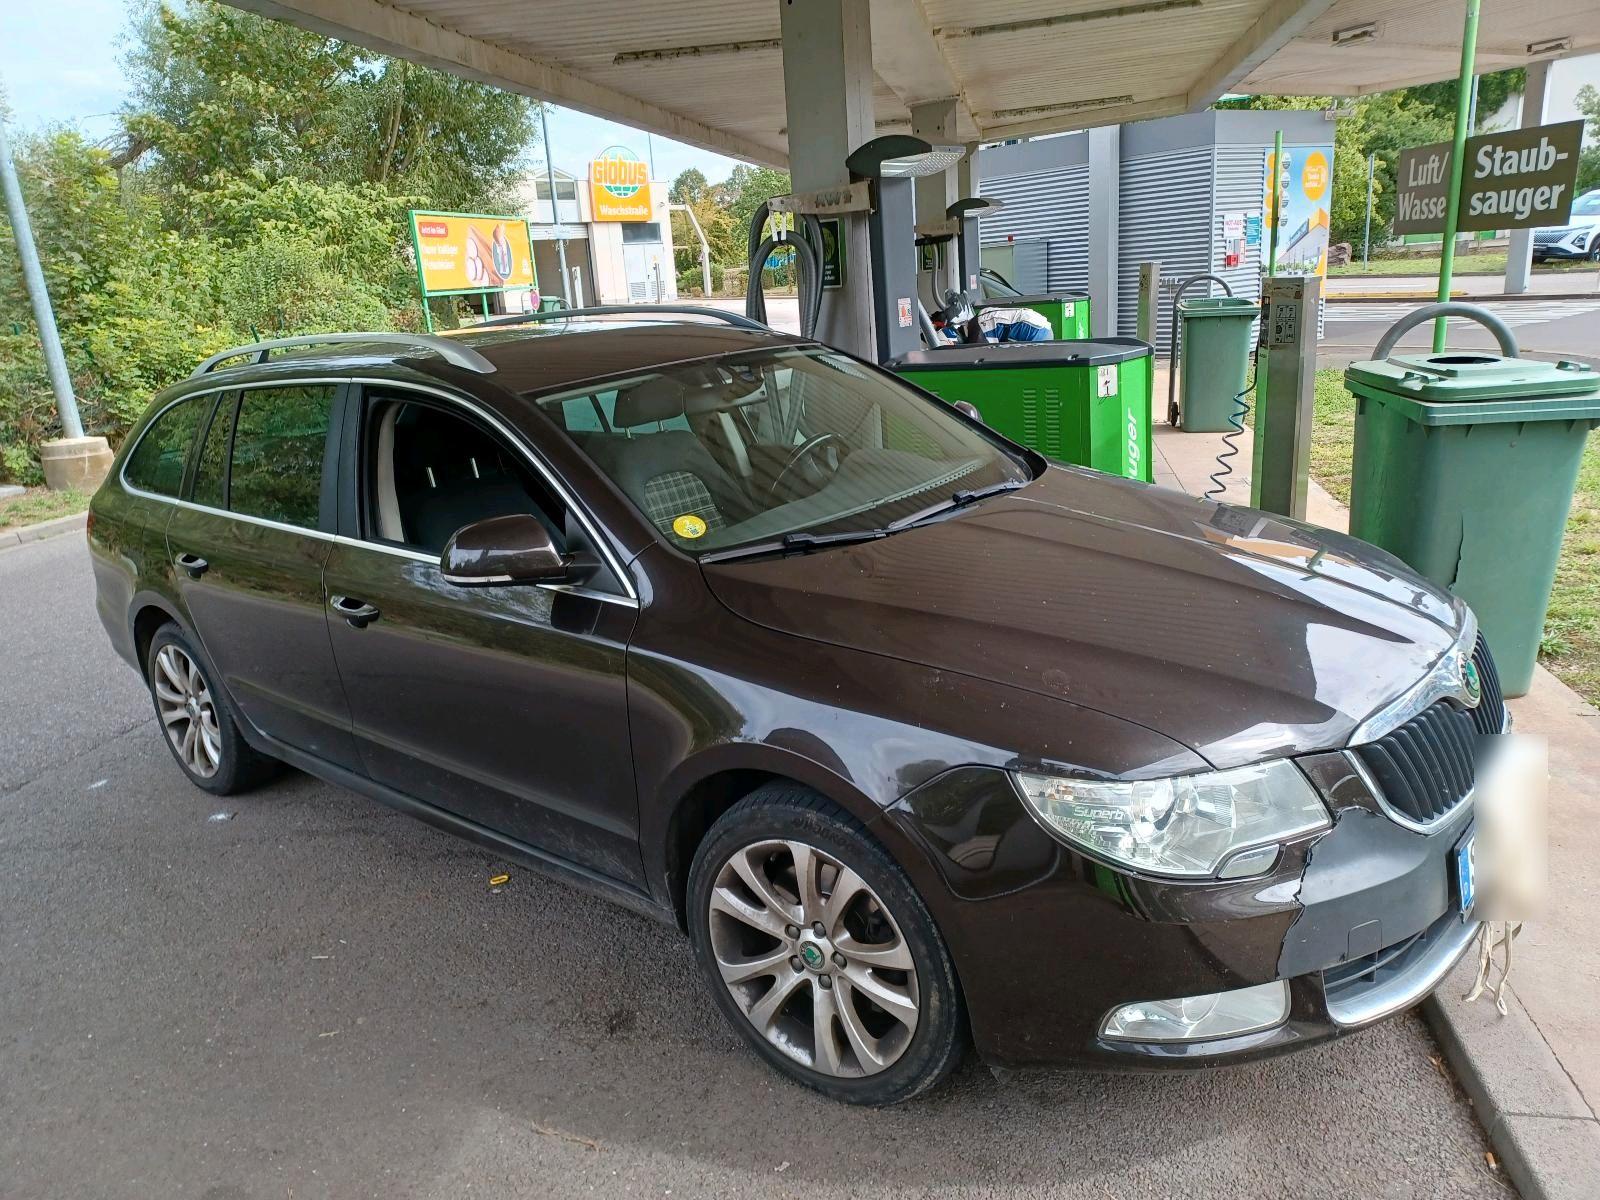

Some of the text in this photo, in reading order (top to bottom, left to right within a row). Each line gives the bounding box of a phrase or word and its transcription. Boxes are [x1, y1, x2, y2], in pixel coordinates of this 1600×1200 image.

[1408, 151, 1450, 188] Luft/
[1474, 136, 1569, 179] Staub-
[600, 204, 649, 217] Waschstraße
[1399, 191, 1447, 221] Wasse
[1469, 184, 1566, 220] sauger
[1074, 806, 1124, 820] Superb
